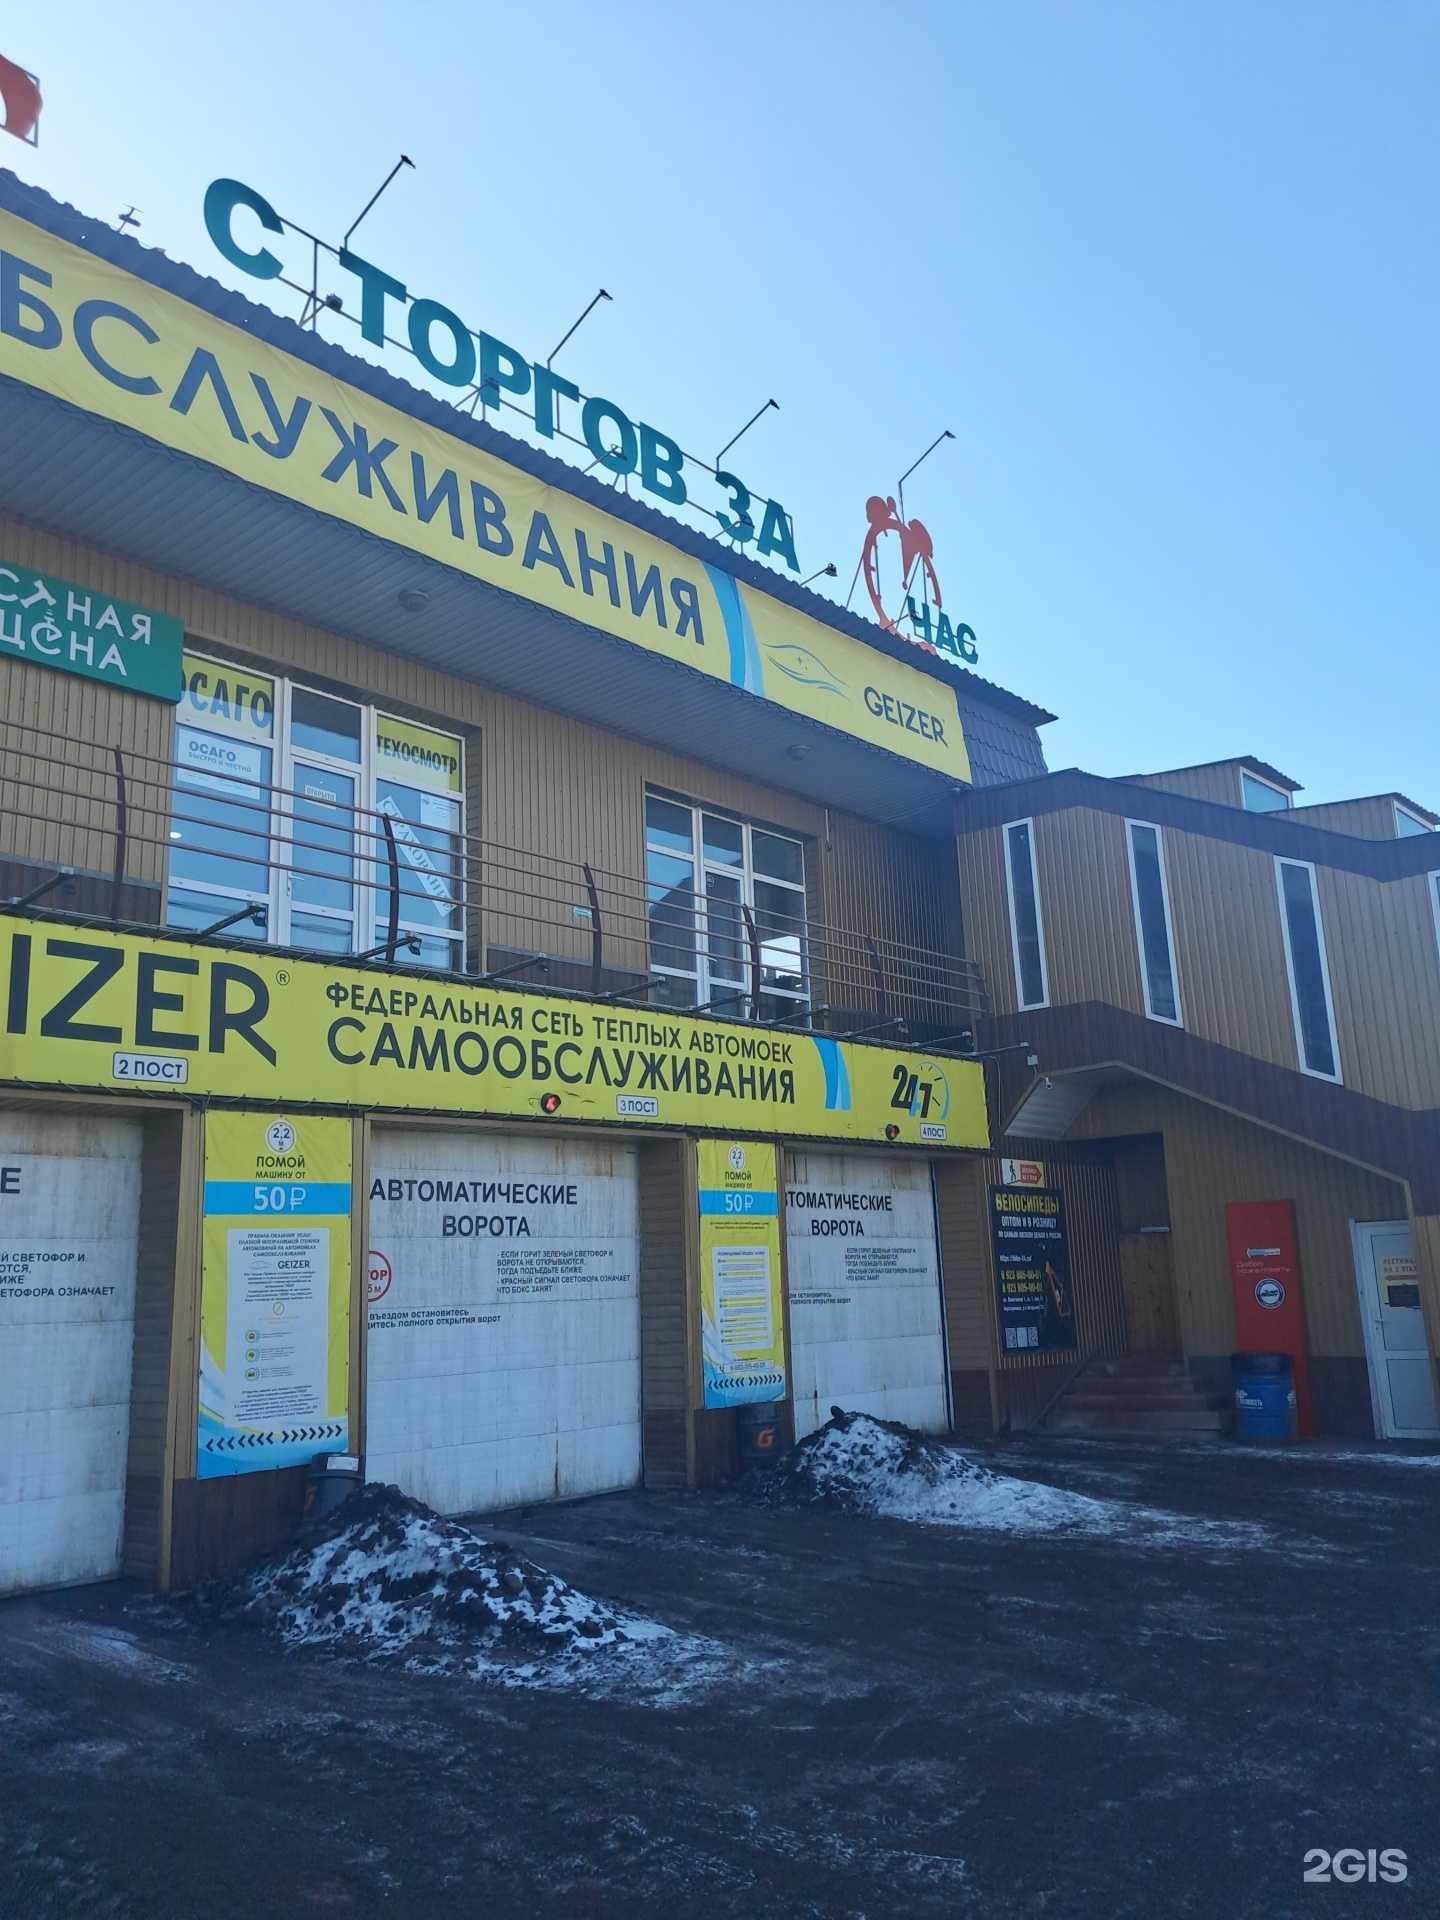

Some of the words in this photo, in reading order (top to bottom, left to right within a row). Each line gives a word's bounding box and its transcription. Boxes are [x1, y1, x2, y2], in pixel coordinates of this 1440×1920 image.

[203, 178, 284, 280] С
[340, 246, 688, 505] ТОРГОВ
[714, 471, 801, 573] ЗА
[907, 597, 978, 664] ЧАС
[181, 668, 273, 729] САГО
[863, 686, 949, 748] GEIZER
[188, 741, 236, 762] ОСАГО
[376, 735, 458, 775] ТЕХОСМОТР
[6, 933, 277, 1067] IZER
[325, 982, 523, 1030] ФЕДЕРАЛЬНАЯ
[531, 1009, 584, 1037] СЕТЬ
[592, 1016, 681, 1049] ТЕПЛЫХ
[688, 1030, 794, 1065] АВТОМОЕК
[118, 1059, 129, 1075] 2
[134, 1060, 183, 1079] ПОСТ
[327, 1016, 796, 1106] САМООБСЛУЖИВАНИЯ
[272, 1127, 290, 1140] 2,2
[256, 1155, 305, 1168] ПОМОЙ
[255, 1171, 293, 1180] МАШИНУ
[294, 1171, 306, 1180] ОТ
[725, 1170, 752, 1180] ПОМОЙ
[369, 1178, 578, 1205] АВТОМАТИЧЕСКИЕ
[995, 1192, 1060, 1215] ВЕЛОСИПЕДЫ
[442, 1215, 531, 1237] ВОРОТА
[811, 1219, 865, 1236] ВОРОТА
[12, 1253, 75, 1263] СВЕТОФОР
[78, 1254, 86, 1262] И
[497, 1258, 524, 1266] ВОРОТА
[525, 1258, 534, 1266] НЕ
[501, 1250, 519, 1258] ЕСЛИ
[520, 1250, 541, 1258] ГОРИТ
[543, 1250, 573, 1258] ЗЕЛЕНЫЙ
[575, 1250, 608, 1258] СВЕТОФОР
[277, 1260, 310, 1270] GEIZER
[497, 1267, 519, 1275] ТОГДА
[500, 1276, 533, 1285] КРАСНЫЙ
[535, 1276, 560, 1284] СИГНАЛ
[561, 1275, 599, 1283] СВЕТОФОРА
[600, 1274, 631, 1283] ОЗНАЧАЕТ
[58, 1287, 115, 1297] ОЗНАЧАЕТ
[497, 1286, 511, 1295] ЧТО
[512, 1286, 529, 1294] БОКС
[531, 1285, 553, 1293] ЗАНЯТ
[398, 1319, 434, 1329] полного
[436, 1316, 477, 1328] открытия
[478, 1314, 501, 1325] ворот
[411, 1309, 470, 1320] остановитесь
